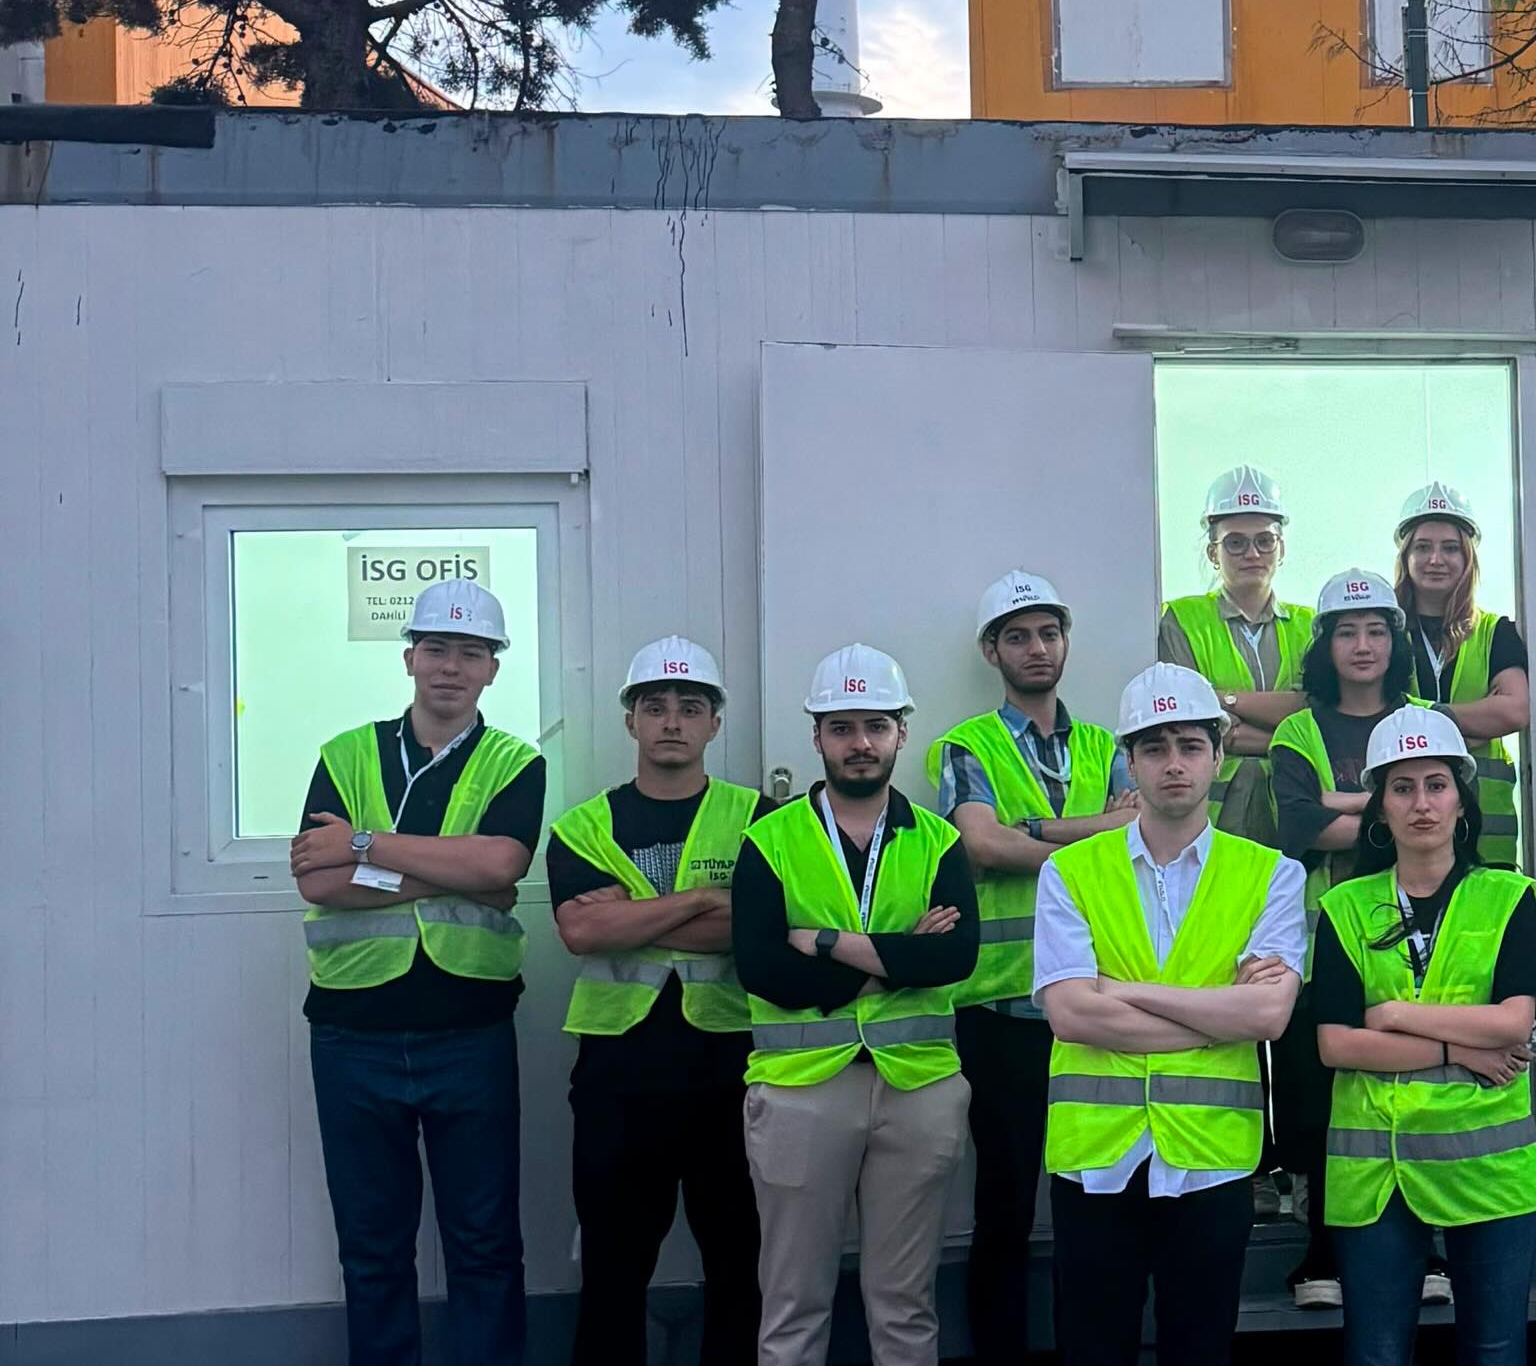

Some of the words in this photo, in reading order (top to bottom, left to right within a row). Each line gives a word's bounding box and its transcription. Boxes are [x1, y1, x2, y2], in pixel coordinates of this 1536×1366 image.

[362, 554, 406, 581] İSG
[416, 554, 478, 581] OFİS
[366, 596, 387, 606] TEL:
[389, 596, 415, 606] 0212
